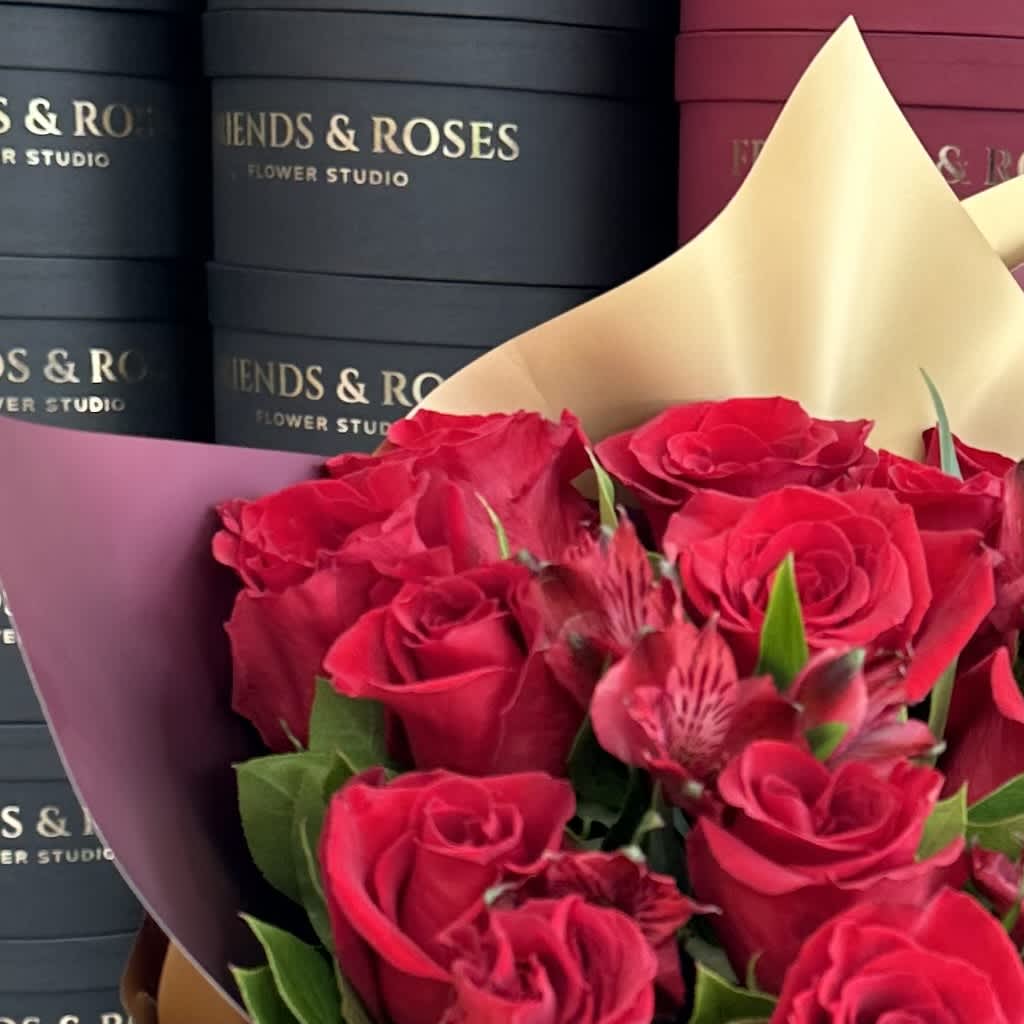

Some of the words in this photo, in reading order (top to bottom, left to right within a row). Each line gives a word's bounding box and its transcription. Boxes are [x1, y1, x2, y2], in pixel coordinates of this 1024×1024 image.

[25, 97, 63, 136] &
[73, 100, 140, 138] RO
[219, 111, 314, 150] IENDS
[325, 113, 360, 152] &
[371, 116, 520, 161] ROSES
[26, 148, 110, 168] STUDIO
[248, 164, 317, 182] FLOWER
[326, 167, 409, 187] STUDIO
[43, 347, 80, 384] &
[231, 356, 325, 401] IENDS
[336, 367, 370, 405] &
[46, 396, 126, 413] STUDIO
[256, 409, 328, 432] FLOWER
[36, 806, 73, 838] &
[37, 848, 115, 865] STUDIO
